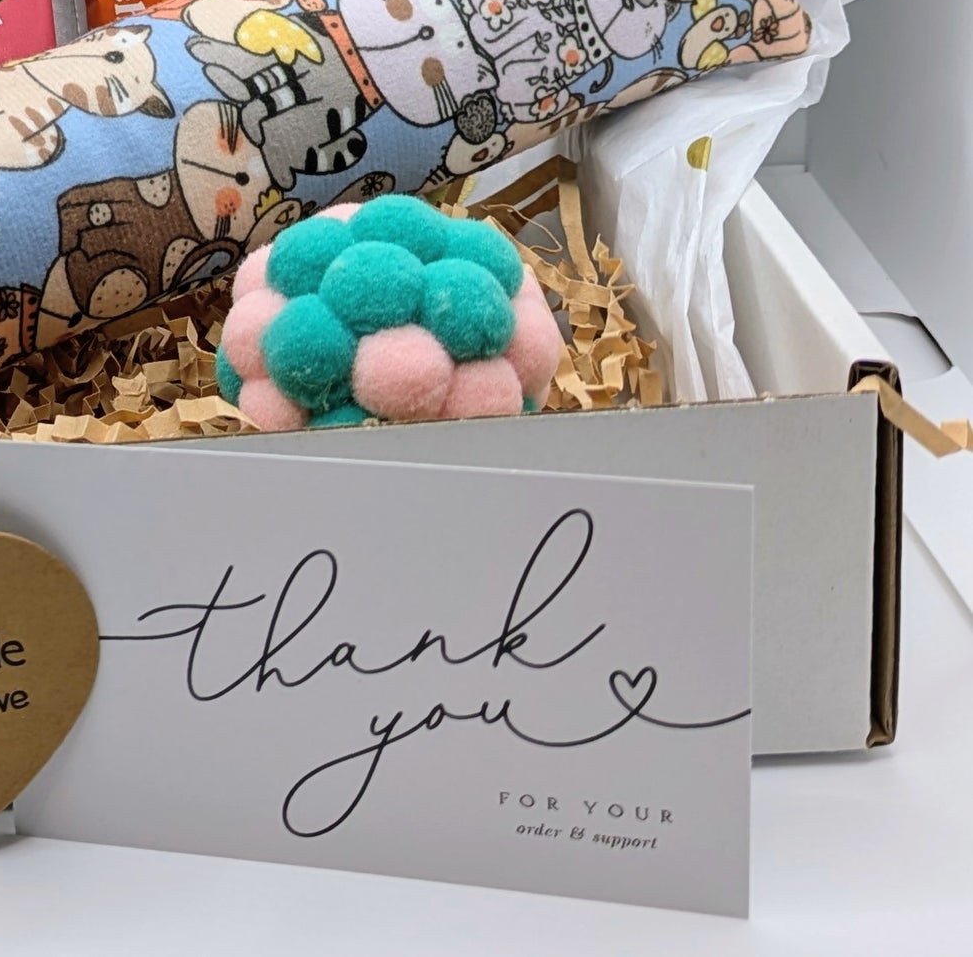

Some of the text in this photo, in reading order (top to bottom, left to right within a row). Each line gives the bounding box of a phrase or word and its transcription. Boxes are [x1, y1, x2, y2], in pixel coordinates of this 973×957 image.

[112, 509, 605, 701] thank
[499, 792, 673, 824] FOR YOUR
[516, 823, 563, 839] order
[592, 832, 658, 850] support
